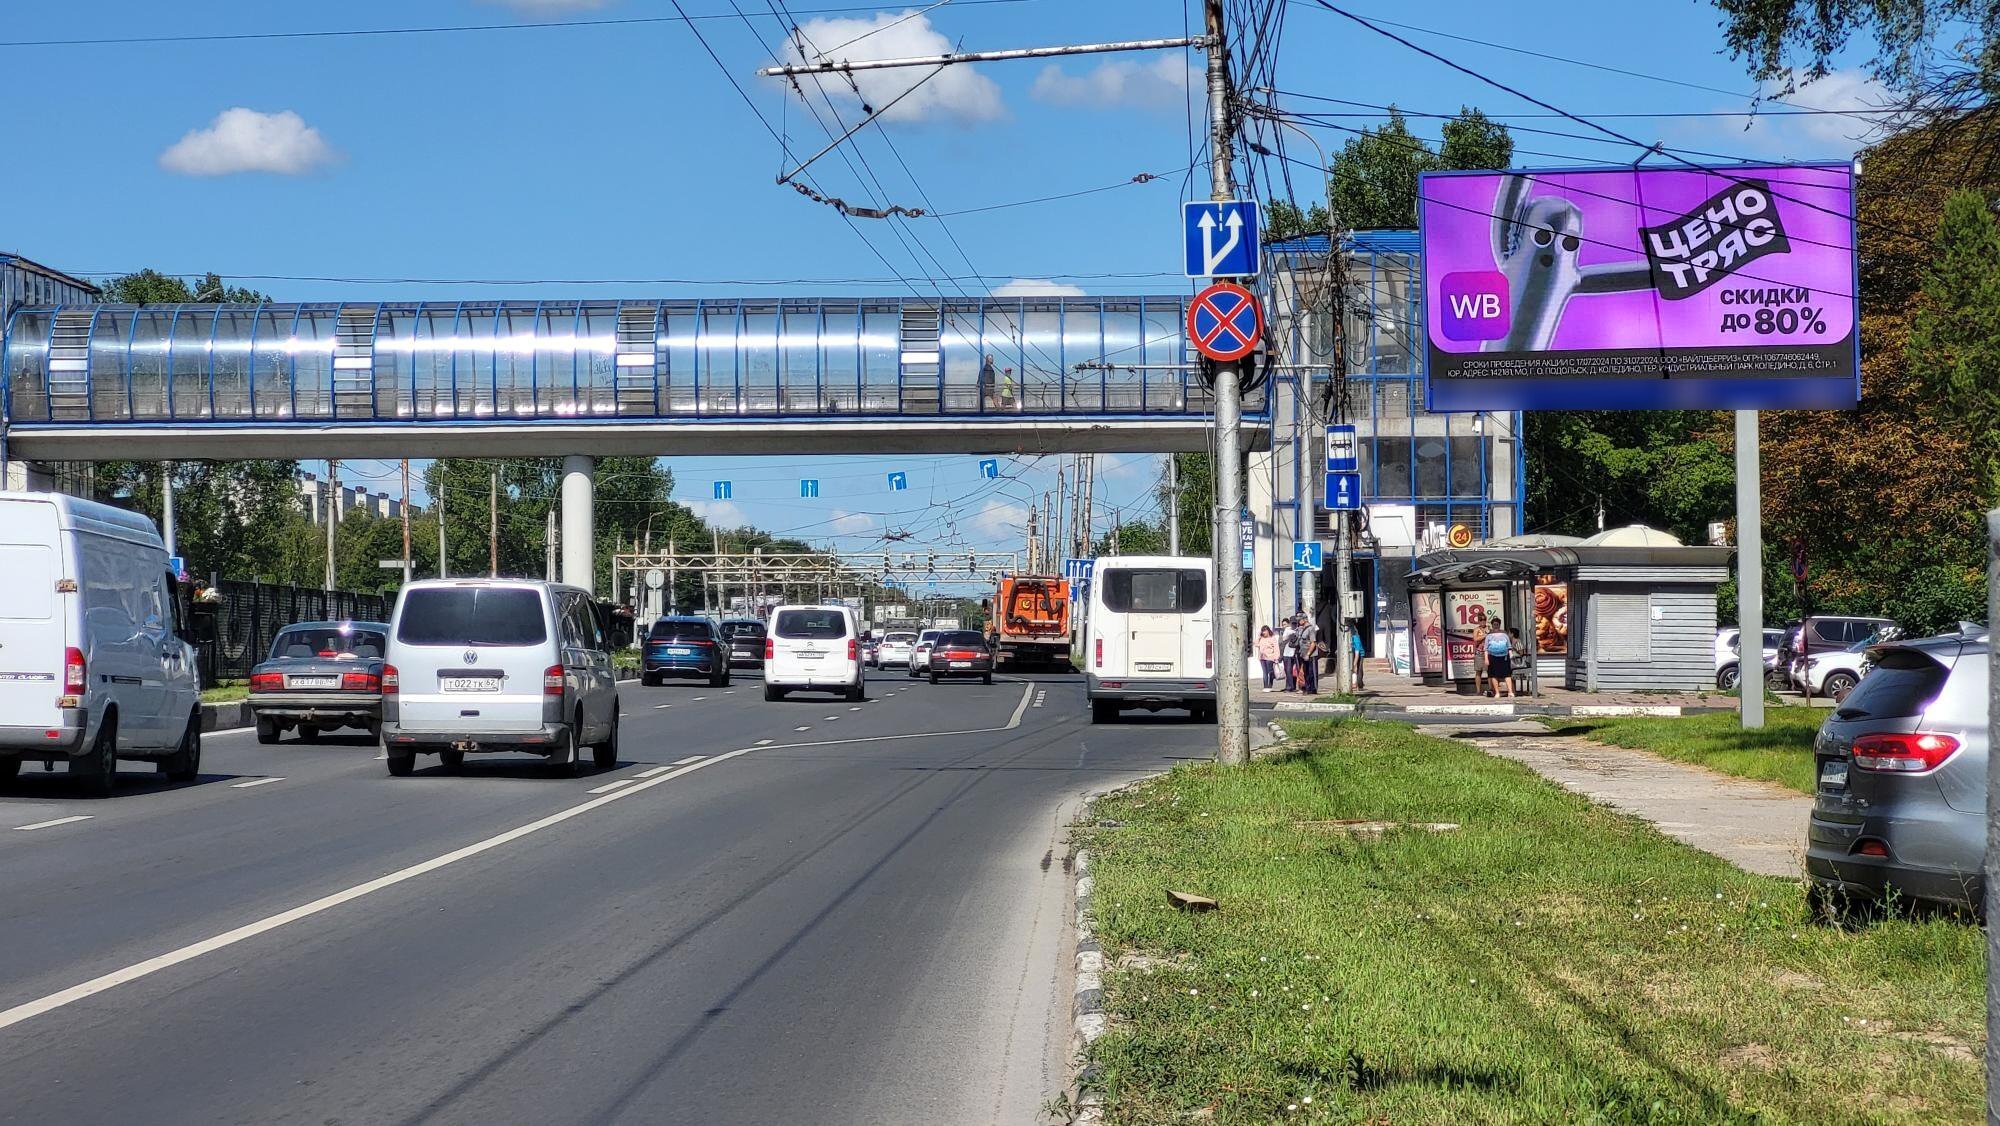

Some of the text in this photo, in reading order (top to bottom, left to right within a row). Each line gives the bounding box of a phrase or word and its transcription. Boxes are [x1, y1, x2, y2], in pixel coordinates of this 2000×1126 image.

[1649, 188, 1767, 259] ЦЕНО
[1659, 217, 1776, 289] ТРЯС
[1449, 293, 1501, 319] WB
[1754, 307, 1827, 335] 80%
[1463, 361, 1489, 369] СРОКИ
[1490, 359, 1541, 369] ПРОВЕДЕНИЯ
[1541, 358, 1569, 368] АКЦИИ
[1569, 358, 1575, 366] С
[1610, 357, 1622, 365] ПО
[1742, 354, 1763, 362] ОГРН
[1736, 362, 1753, 370] ПАРК
[1454, 532, 1468, 541] 24
[1452, 644, 1474, 654] ВКЛ
